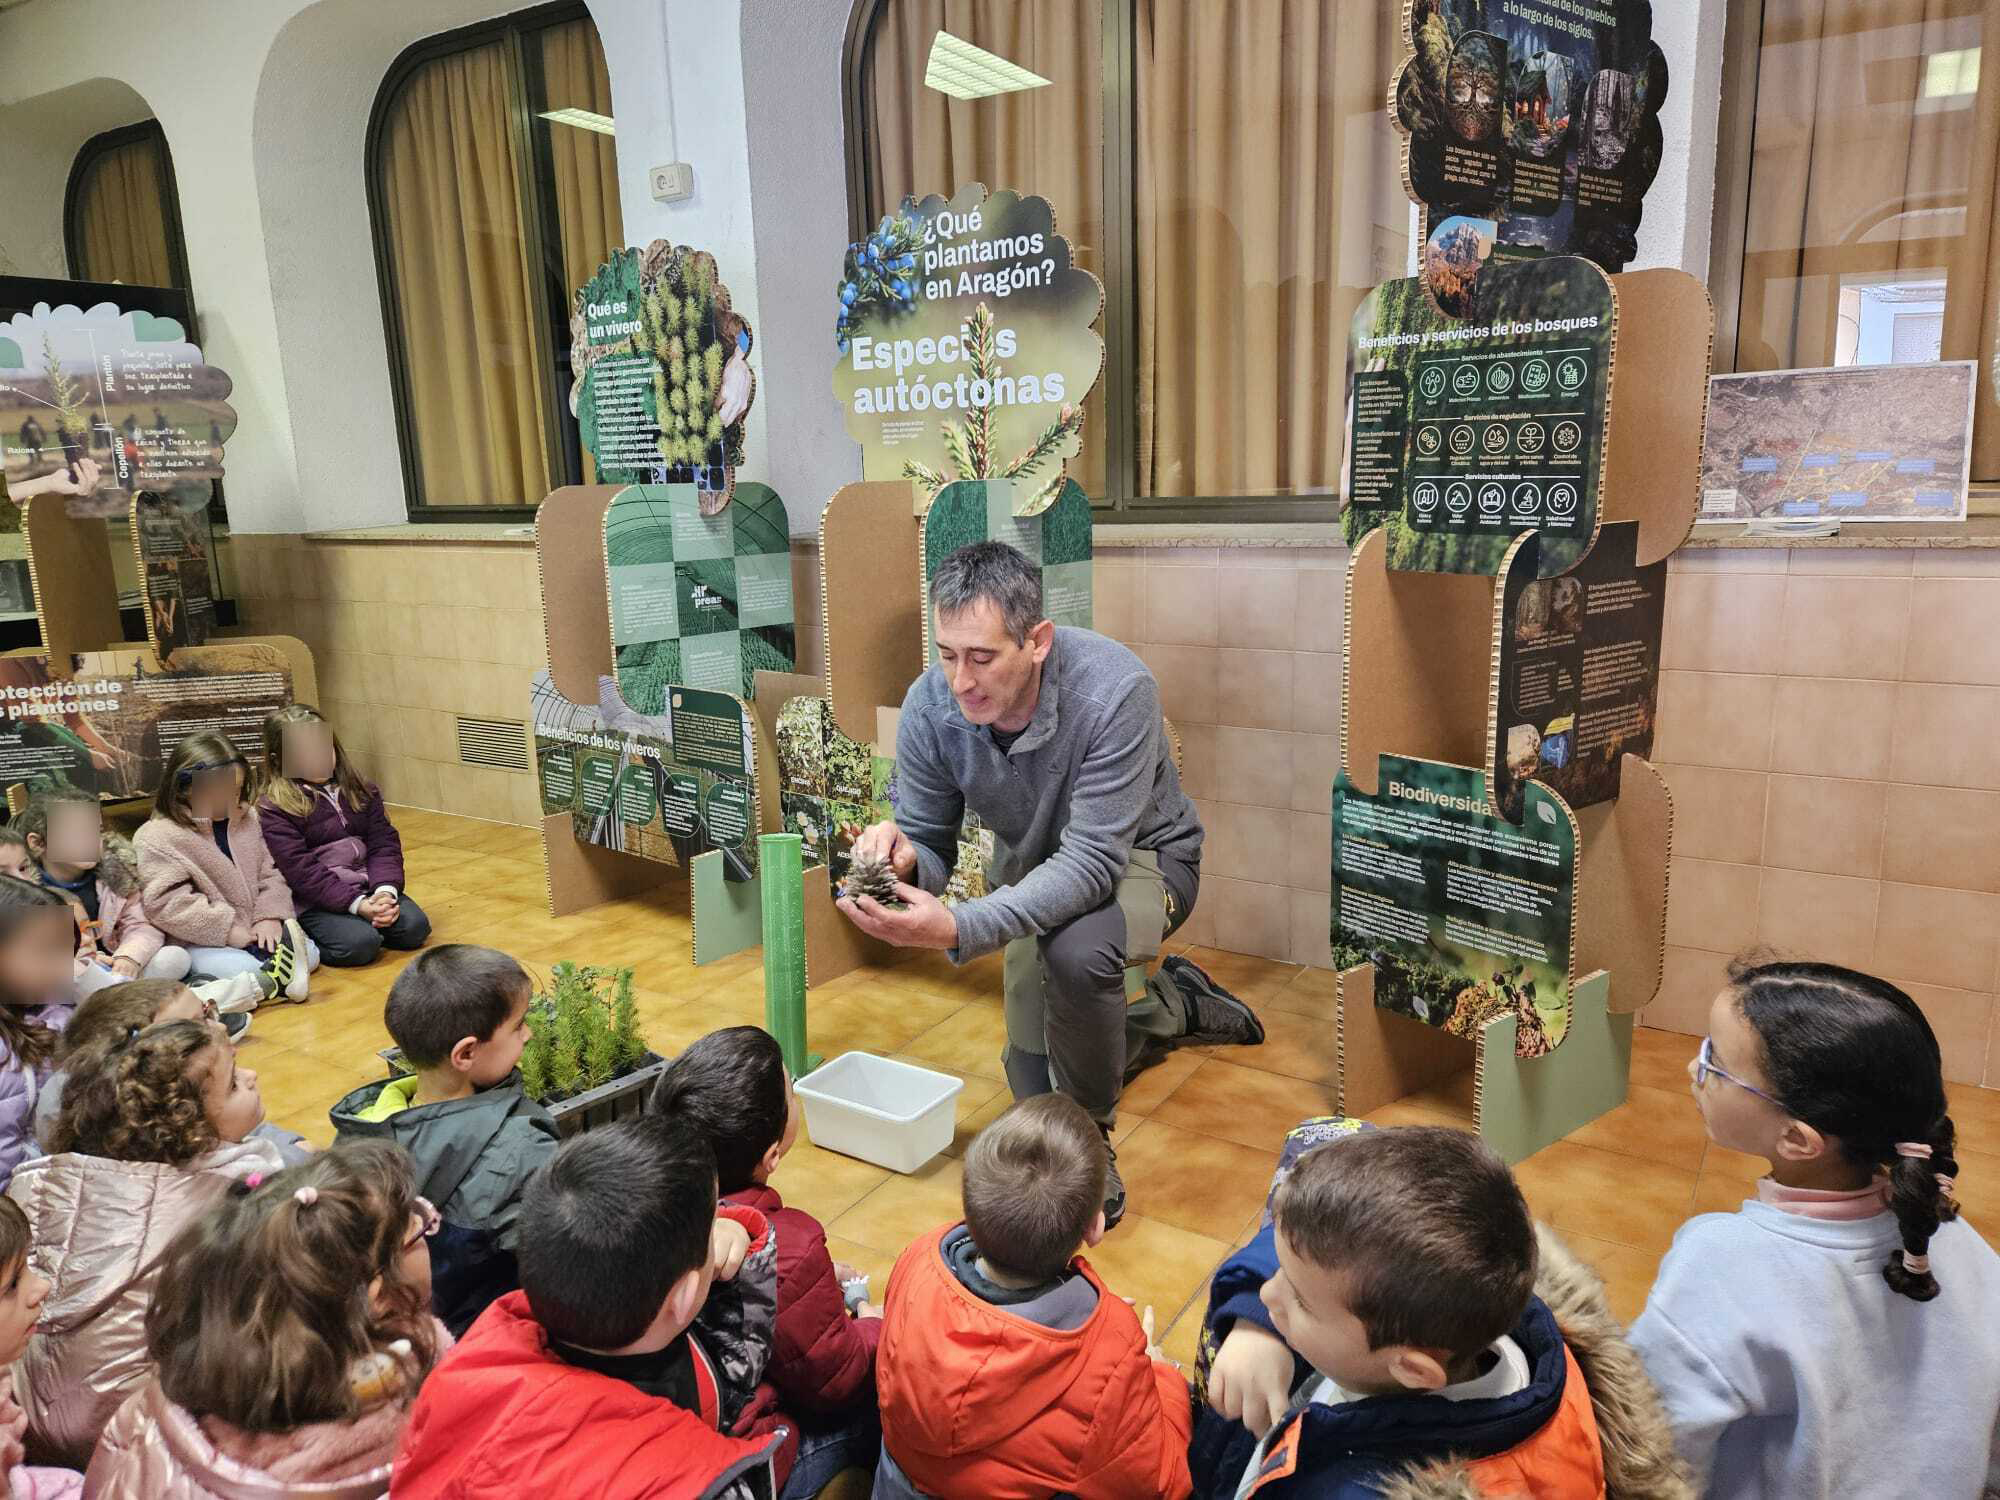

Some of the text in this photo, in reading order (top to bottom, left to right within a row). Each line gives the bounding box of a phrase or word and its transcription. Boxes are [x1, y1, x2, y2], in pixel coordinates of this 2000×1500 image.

[1503, 1, 1595, 40] a lo largo de los siglos.
[1561, 0, 1617, 27] de los pueblos
[923, 205, 982, 244] ¿Qué
[925, 232, 1044, 275] plantamos
[925, 259, 1056, 300] en Aragón?
[588, 301, 628, 319] Qué es
[590, 319, 643, 338] un vivero
[852, 324, 1017, 376] Especis
[1358, 315, 1599, 349] Beneficios y servicios de los bosques
[105, 354, 116, 392] Plantón
[1461, 354, 1488, 362] Servicios
[854, 372, 1065, 415] autóctonas
[115, 436, 129, 479] Cepellón
[0, 680, 90, 700] otección
[91, 680, 123, 695] de
[8, 698, 120, 721] plantones
[539, 724, 661, 760] Beneficios de los viveros
[1389, 781, 1493, 818] Biodiversida
